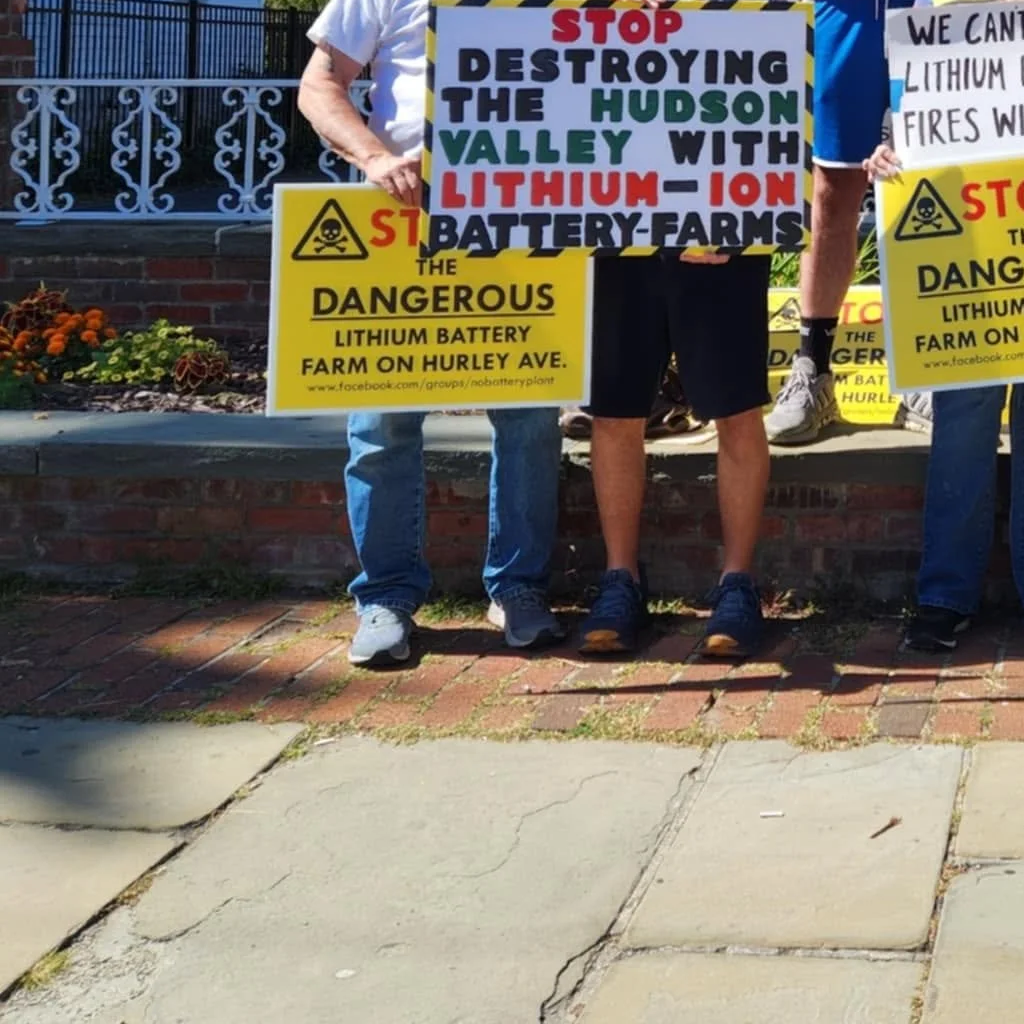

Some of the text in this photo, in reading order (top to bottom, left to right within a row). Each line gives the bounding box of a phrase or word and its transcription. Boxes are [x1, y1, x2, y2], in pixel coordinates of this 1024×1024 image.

[552, 9, 682, 44] STOP
[907, 14, 952, 46] WE
[458, 48, 788, 84] DESTROYING
[905, 56, 1006, 93] LITHIUM
[441, 87, 798, 124] THE HUDSON
[903, 107, 981, 147] FIRES
[439, 129, 799, 166] VALLEY WITH
[369, 208, 420, 248] ST
[428, 211, 804, 251] BATTERY-FARMS
[416, 259, 457, 276] THE
[312, 284, 555, 316] DANGEROUS
[842, 302, 883, 325] TO
[335, 326, 532, 347] LITHIUM BATTERY
[845, 331, 875, 343] THE
[915, 331, 976, 353] FARM
[984, 326, 1020, 345] ON
[301, 351, 567, 375] FARM ON HURLEY AVE.
[307, 376, 555, 392] www.facebook.com/groups/nobatteryplant
[842, 392, 896, 404] HURLE
